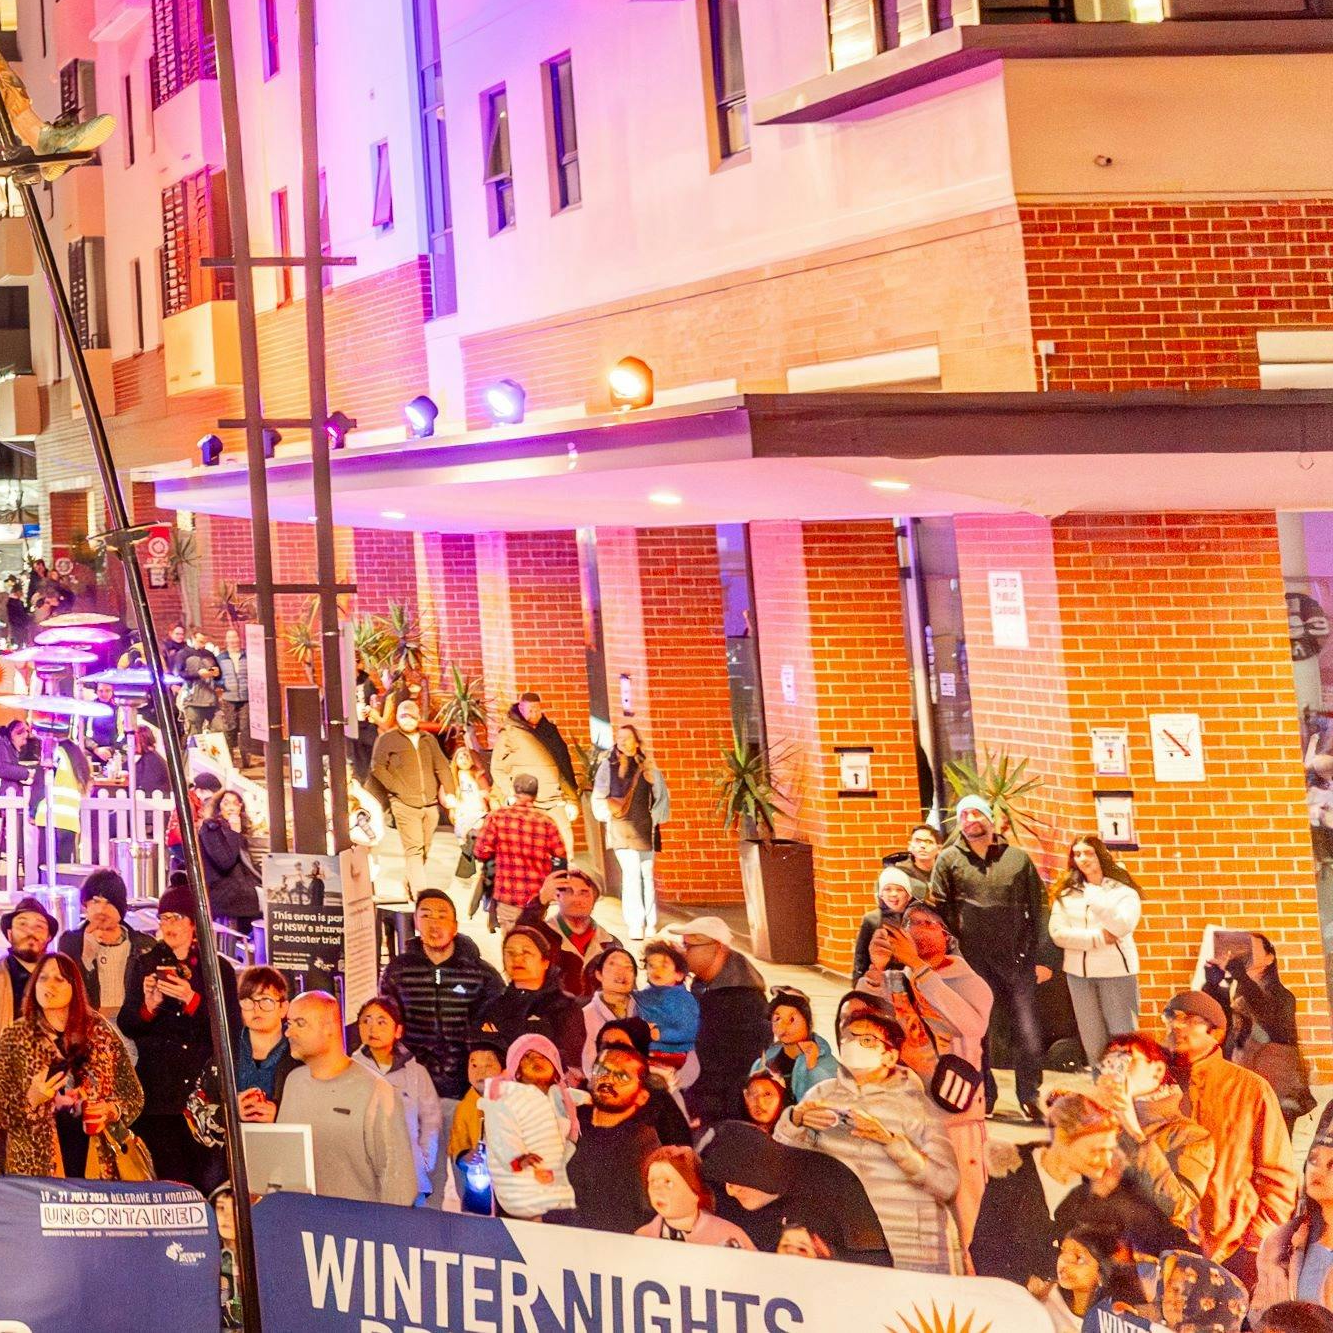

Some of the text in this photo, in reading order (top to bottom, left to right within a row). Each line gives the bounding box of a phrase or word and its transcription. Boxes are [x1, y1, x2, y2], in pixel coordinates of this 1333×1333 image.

[273, 910, 343, 925] This area is par
[273, 922, 283, 931] of
[314, 925, 344, 934] share
[321, 936, 341, 945] trial
[70, 1191, 88, 1203] JULY
[44, 1207, 204, 1225] UNCONTAINED
[301, 1231, 539, 1333] WINTER
